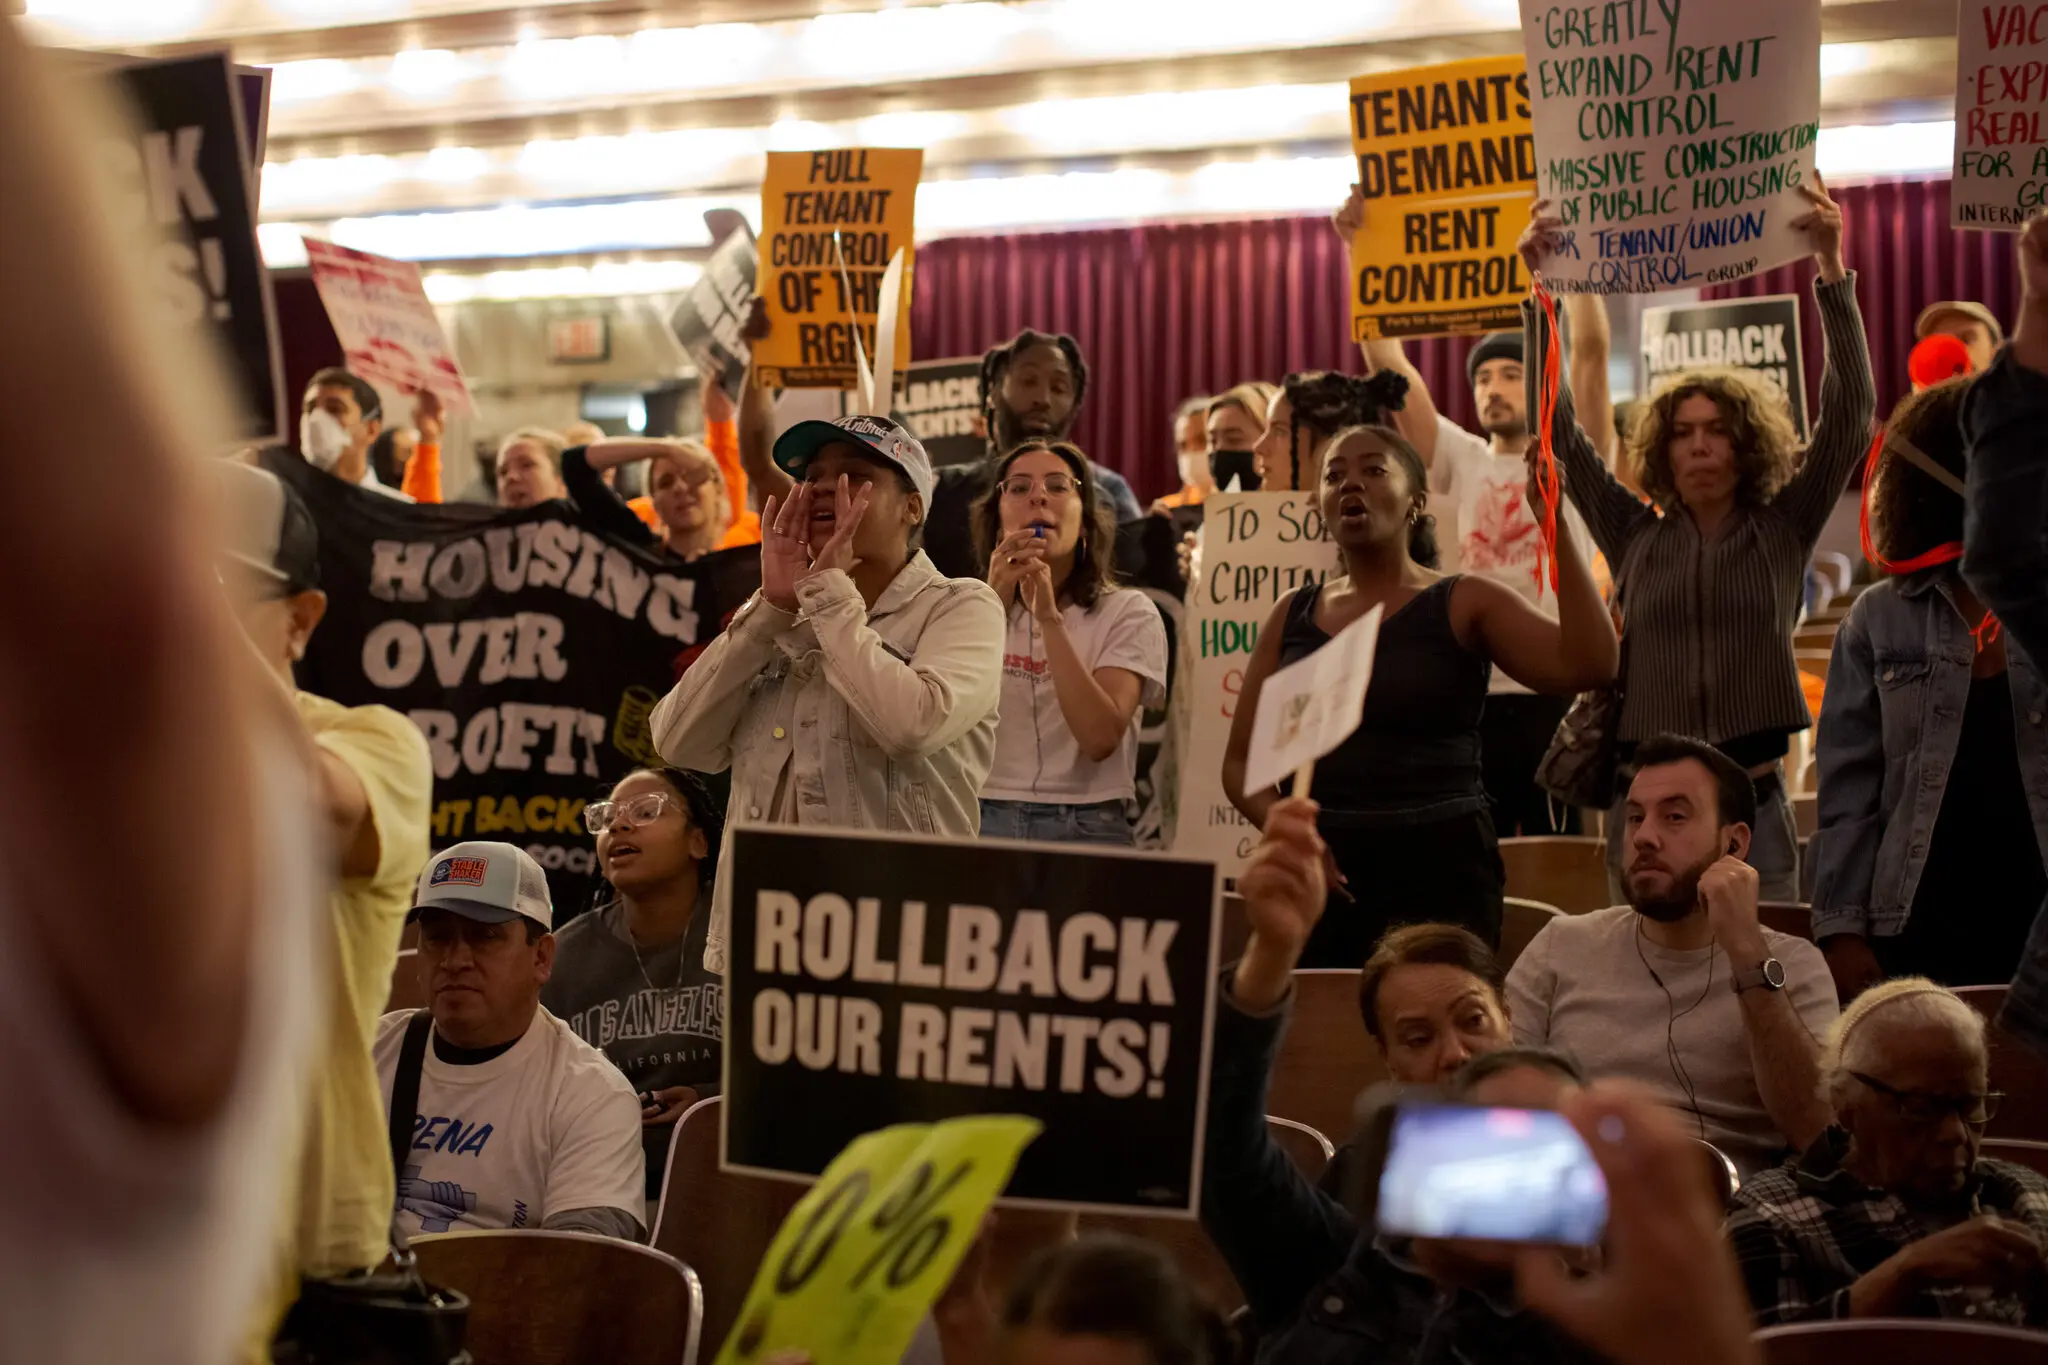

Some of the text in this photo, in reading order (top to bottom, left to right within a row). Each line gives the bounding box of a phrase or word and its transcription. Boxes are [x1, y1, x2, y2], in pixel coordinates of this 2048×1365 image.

[1545, 0, 1681, 74] GREATLY
[1538, 36, 1777, 99] EXPAND RENT
[1977, 61, 2048, 107] EXP
[1350, 72, 1531, 140] TENANTS
[1578, 92, 1735, 142] CONTROL
[809, 150, 870, 184] FULL
[1360, 133, 1537, 199] DEMAND
[1549, 117, 1819, 194] MASSIVE CONSTRUCTION
[1960, 151, 2014, 178] FOR
[784, 189, 892, 225] TENANT
[1561, 159, 1802, 226] OF PUBLIC HOUSING
[772, 231, 890, 267] CONTROL
[1405, 206, 1500, 254] RENT
[779, 271, 822, 313] OF
[1359, 254, 1526, 307] CONTROL
[1588, 255, 1703, 286] CONTROL
[1707, 257, 1758, 283] GROUP
[1647, 323, 1788, 373] ROLLBACK
[1216, 502, 1259, 543] TO
[369, 519, 700, 646] HOUSING
[361, 611, 568, 689] OVER
[475, 794, 588, 836] BACK
[754, 888, 1181, 1007] ROLLBACK
[752, 988, 1171, 1099] OUR RENTS!
